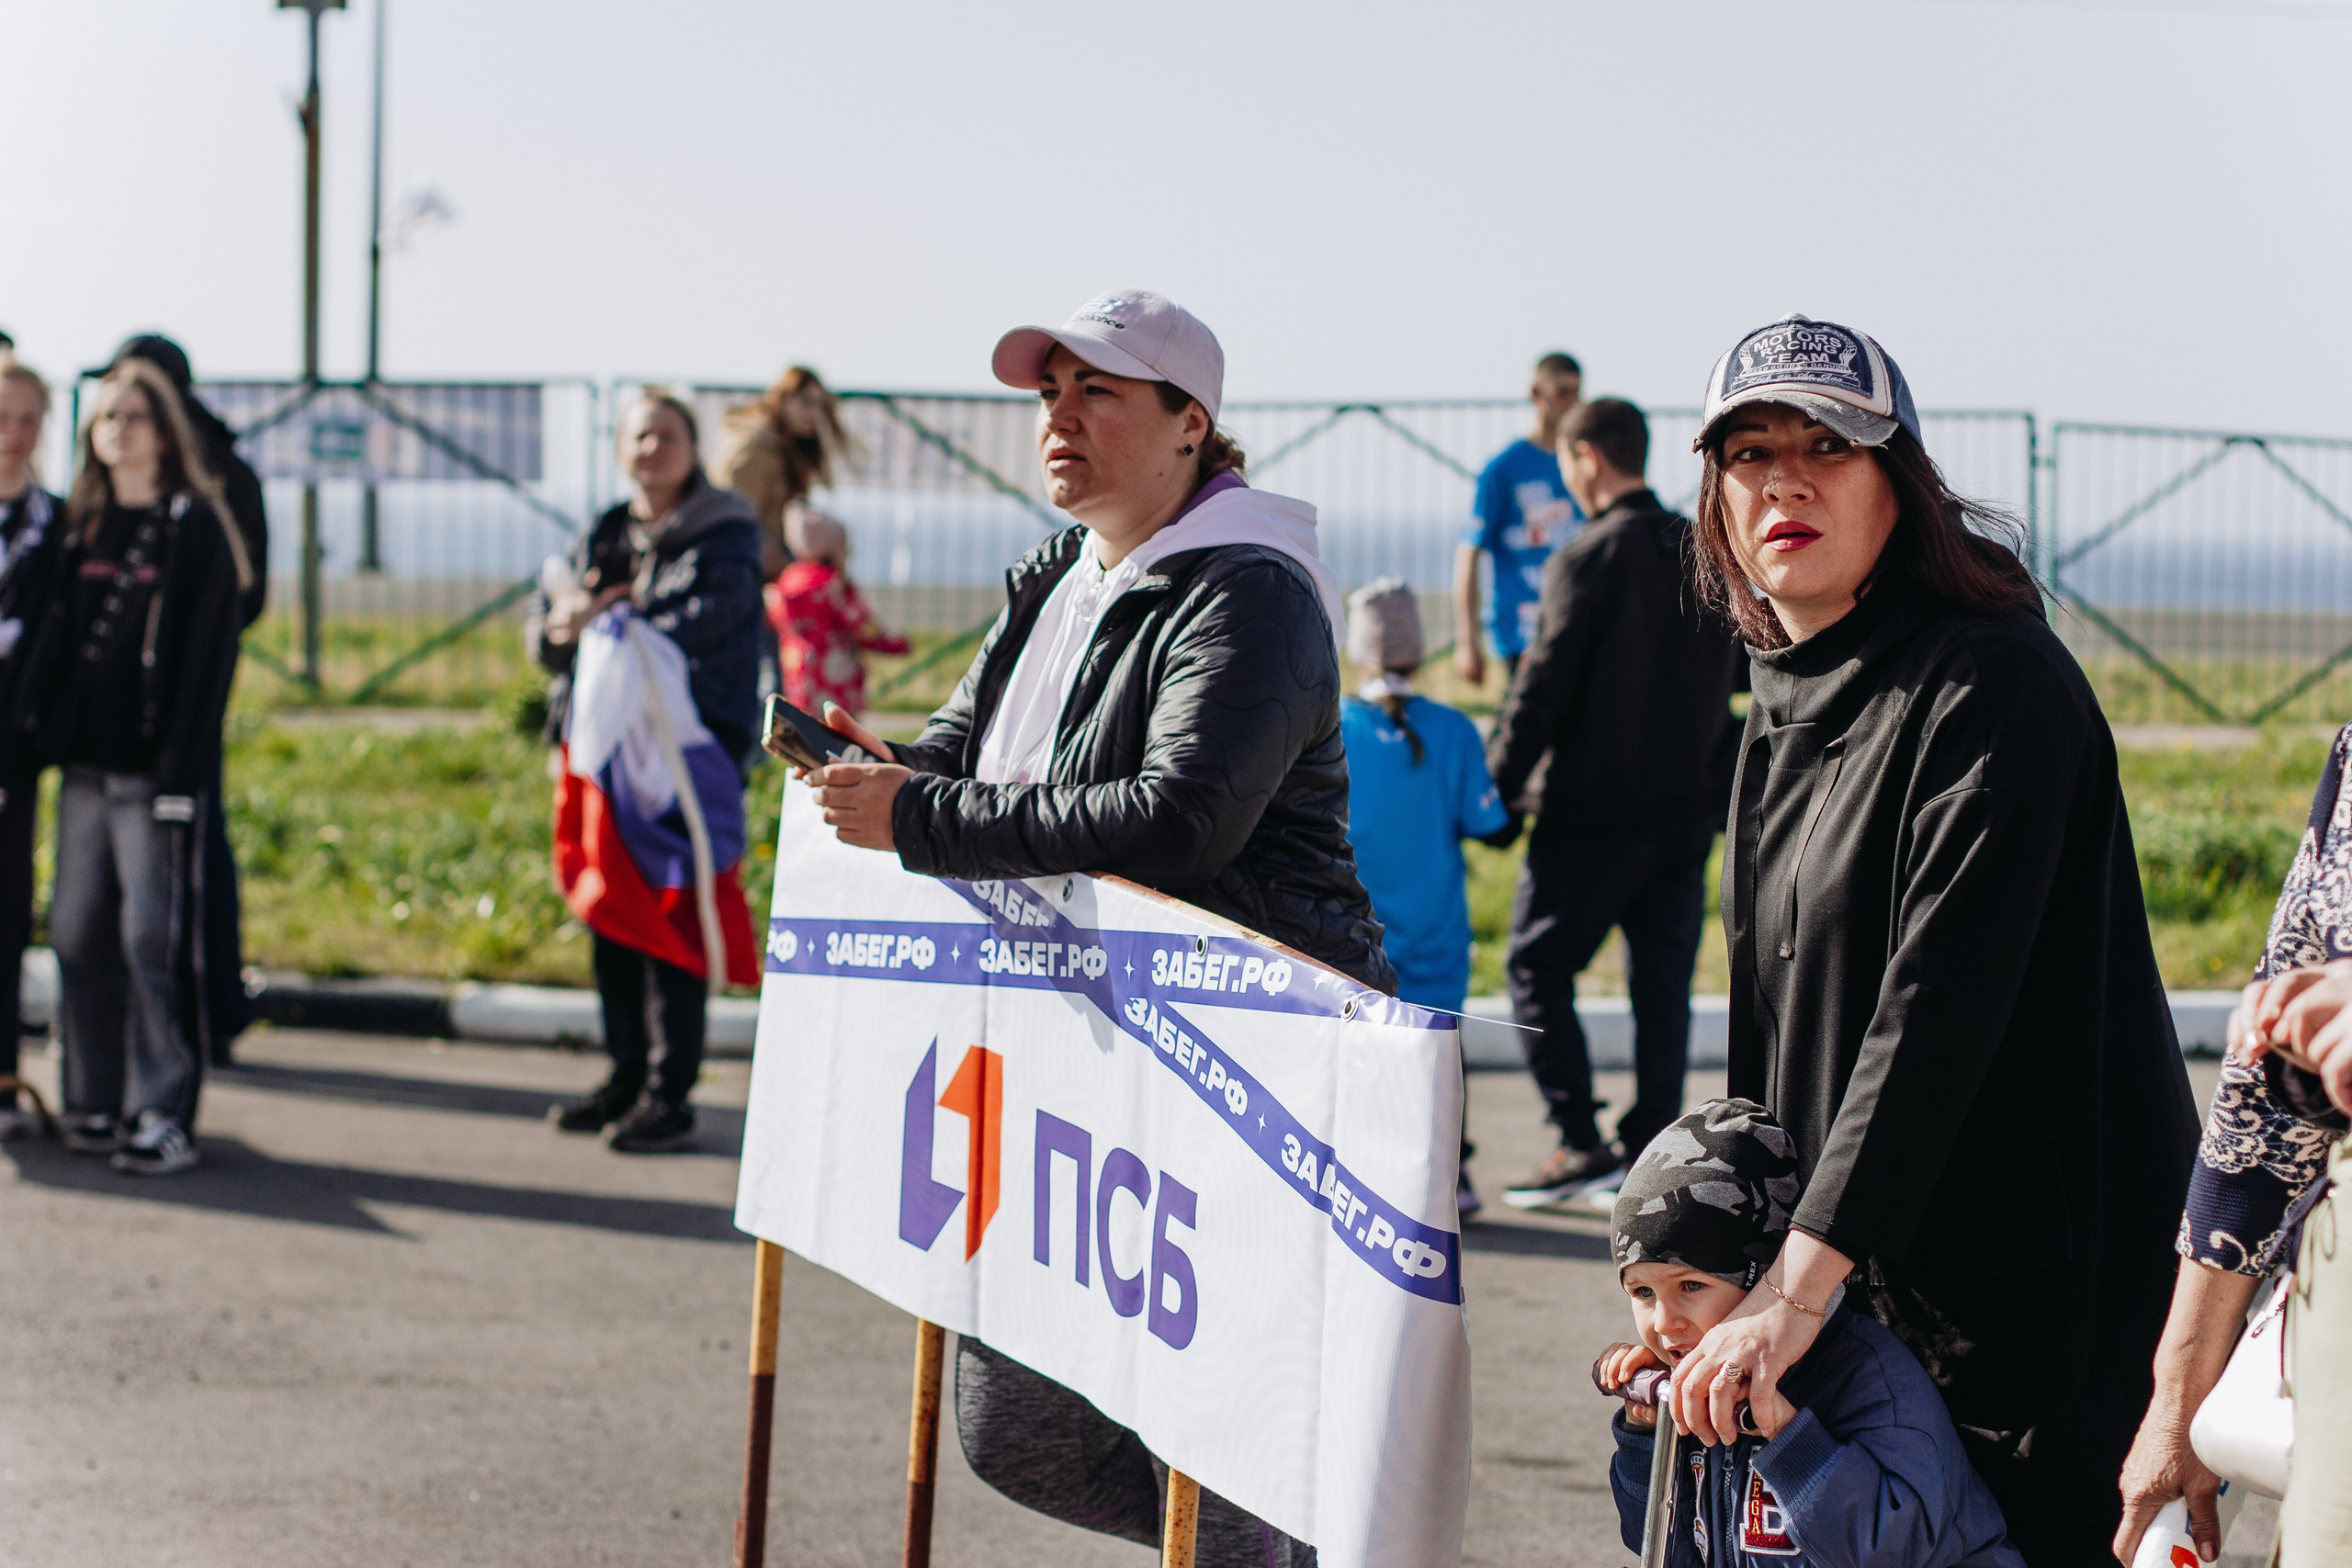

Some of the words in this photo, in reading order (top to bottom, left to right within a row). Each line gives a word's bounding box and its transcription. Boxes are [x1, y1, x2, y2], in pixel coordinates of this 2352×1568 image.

[1754, 330, 1842, 354] MOTORS
[1760, 340, 1838, 358] RACING
[1766, 353, 1830, 365] TEAM
[825, 931, 936, 971] ЗАБЕГ.РФ
[978, 939, 1108, 980] ЗАБЕГ.РФ
[1151, 949, 1293, 997] ЗАБЕГ.РФ
[1124, 997, 1249, 1117] ЗАБЕГ.РФ
[1034, 1108, 1198, 1351] ПСБ
[1746, 1260, 1756, 1287] T-REX
